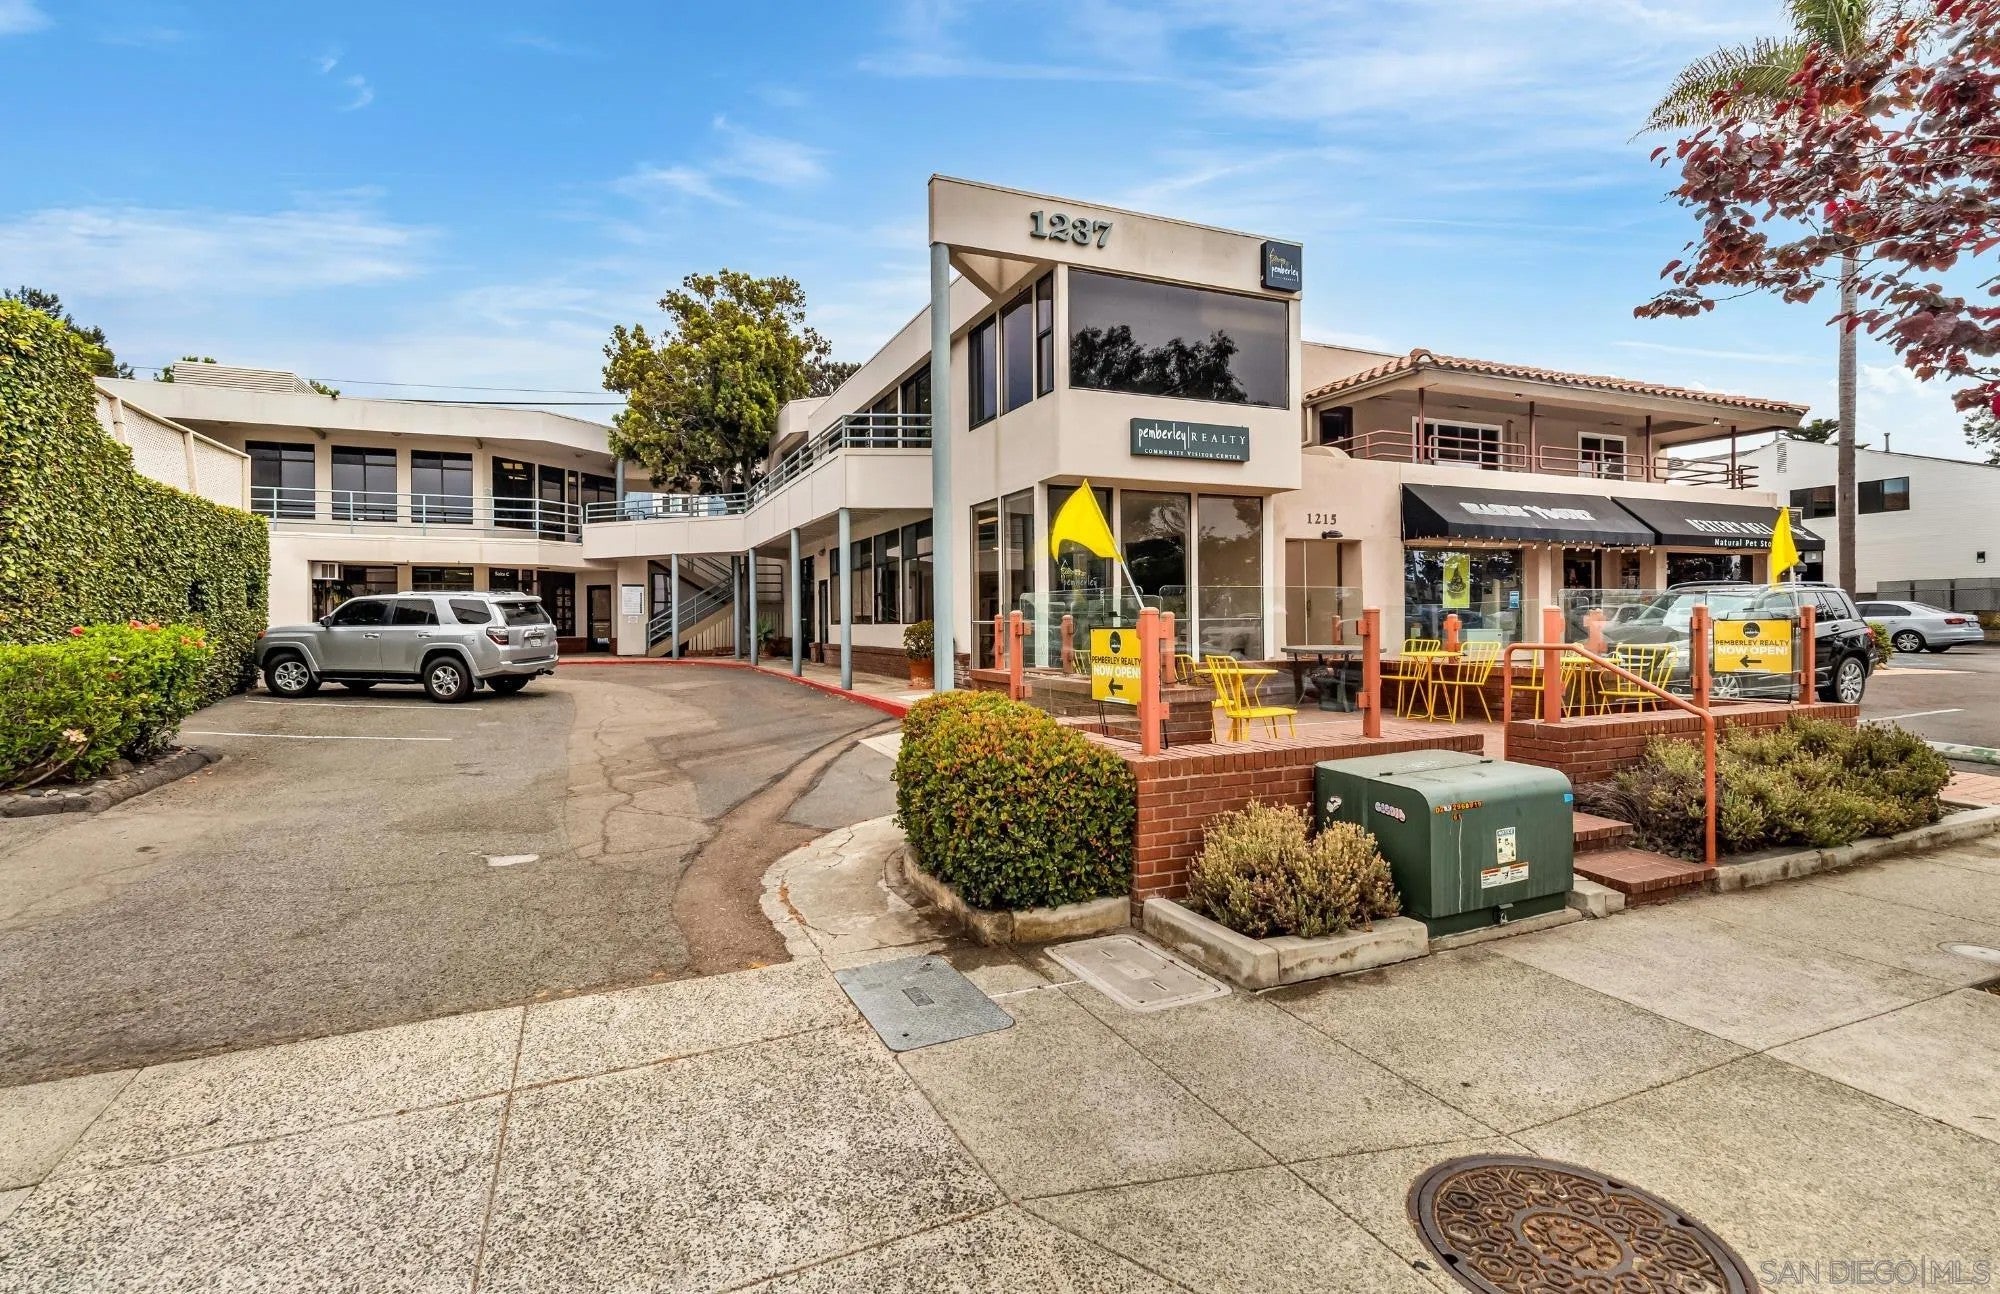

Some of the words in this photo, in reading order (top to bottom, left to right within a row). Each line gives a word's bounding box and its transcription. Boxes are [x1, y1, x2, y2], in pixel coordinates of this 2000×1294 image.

[1030, 210, 1113, 248] 1237
[1138, 422, 1187, 450] pemberley
[1191, 432, 1246, 445] REALTY
[1144, 448, 1184, 456] COMMUNITY
[1187, 451, 1213, 459] VISITOR
[1307, 513, 1337, 525] 1215
[1714, 538, 1742, 547] Natural
[1760, 540, 1772, 548] Sto
[1718, 645, 1747, 655] NOW
[1750, 646, 1787, 655] OPEN!
[1092, 655, 1120, 665] PEMBERLEY
[1121, 657, 1141, 666] REALTY
[1094, 665, 1113, 677] NOW
